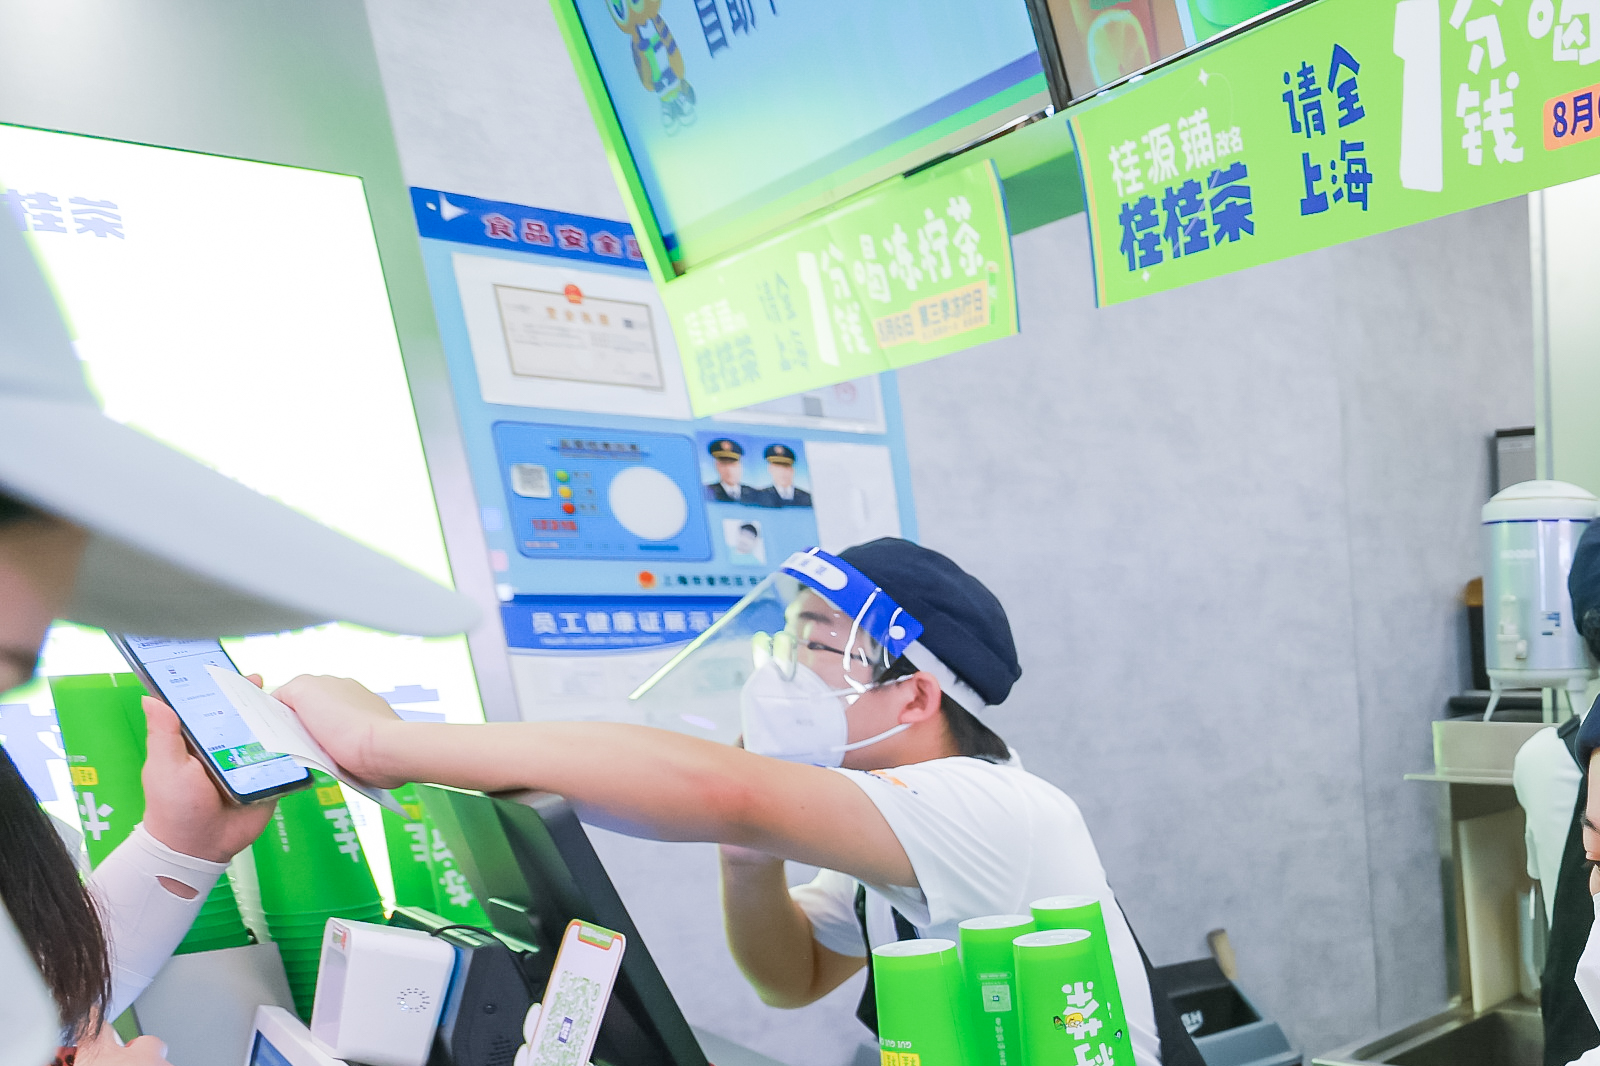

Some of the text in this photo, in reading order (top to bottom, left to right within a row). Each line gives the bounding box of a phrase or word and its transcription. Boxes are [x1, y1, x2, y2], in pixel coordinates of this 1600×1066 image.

[1282, 43, 1366, 138] 请全
[1109, 107, 1215, 197] 桂源铺
[1300, 140, 1373, 216] 上海
[1118, 161, 1254, 271] 桂桂茶
